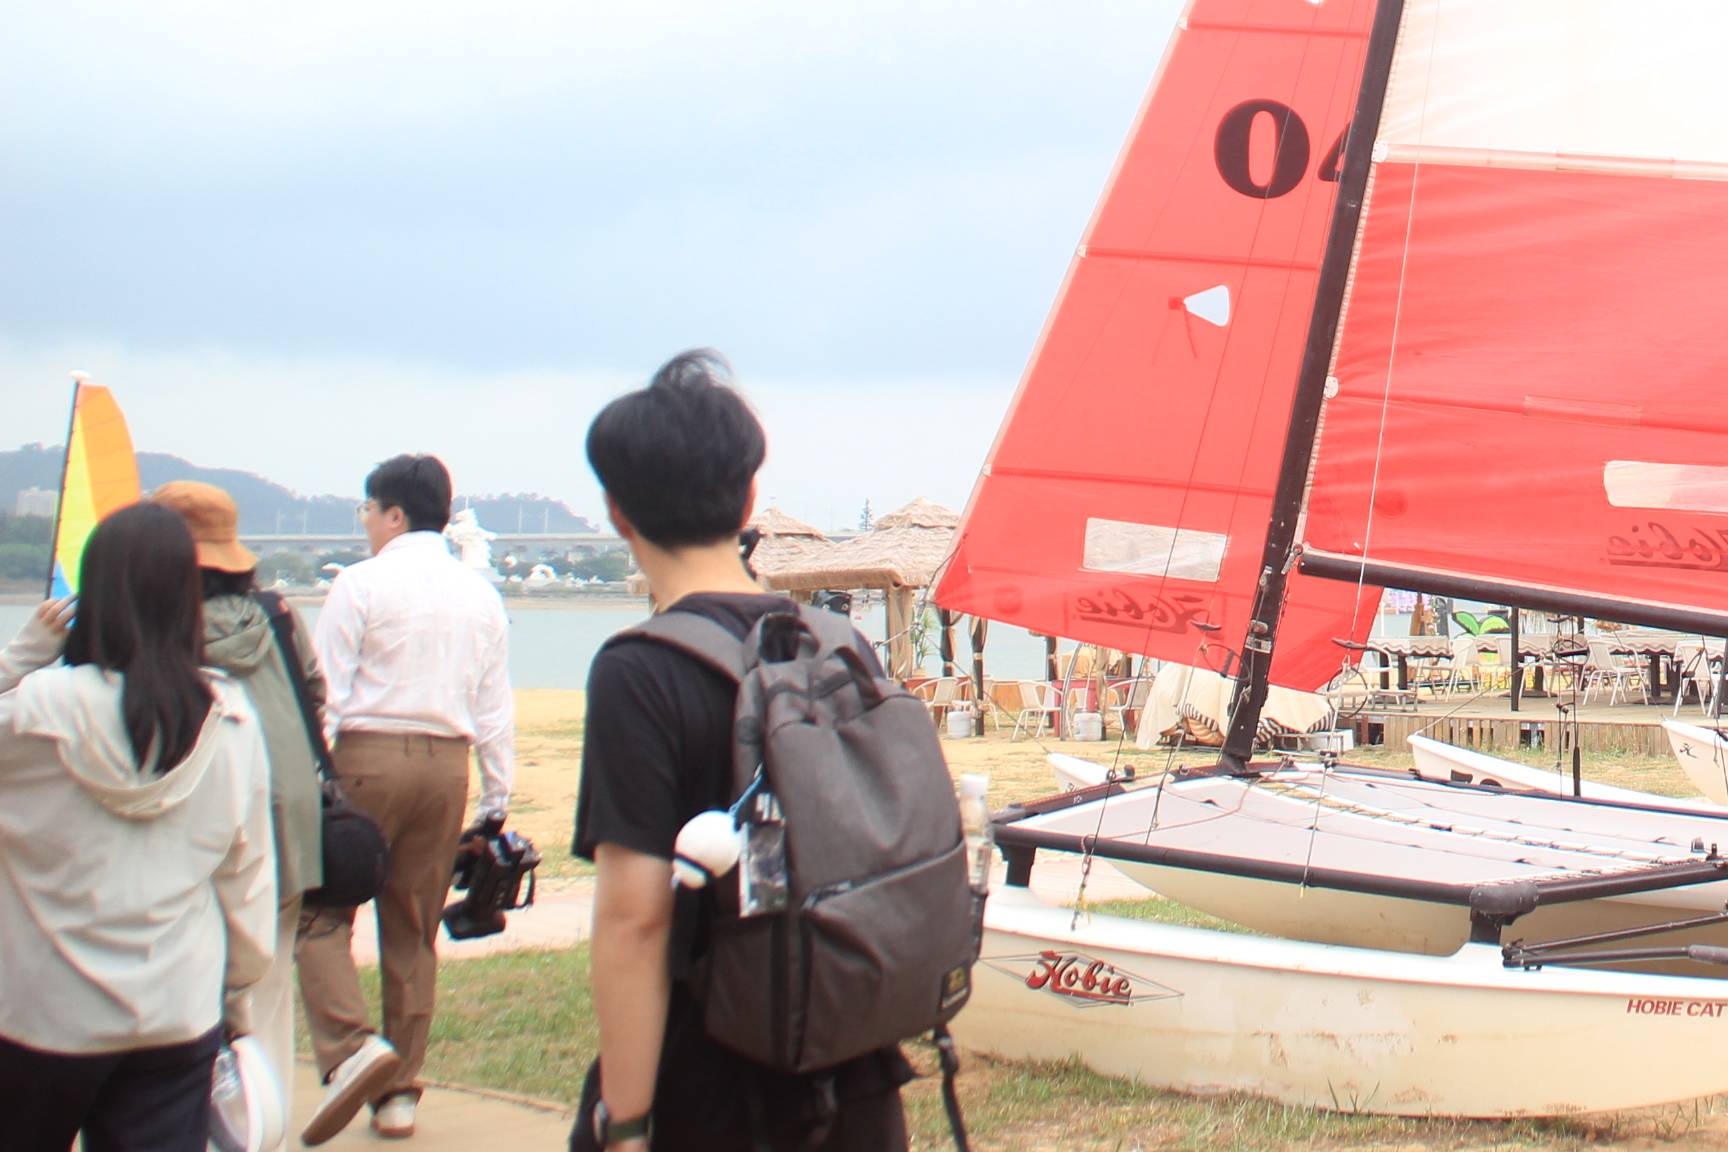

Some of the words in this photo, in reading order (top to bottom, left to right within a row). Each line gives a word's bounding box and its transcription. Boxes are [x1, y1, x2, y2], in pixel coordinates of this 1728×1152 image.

[1024, 950, 1133, 1006] Hobie
[1626, 999, 1683, 1016] HOBIE
[1686, 1001, 1728, 1018] CAT
